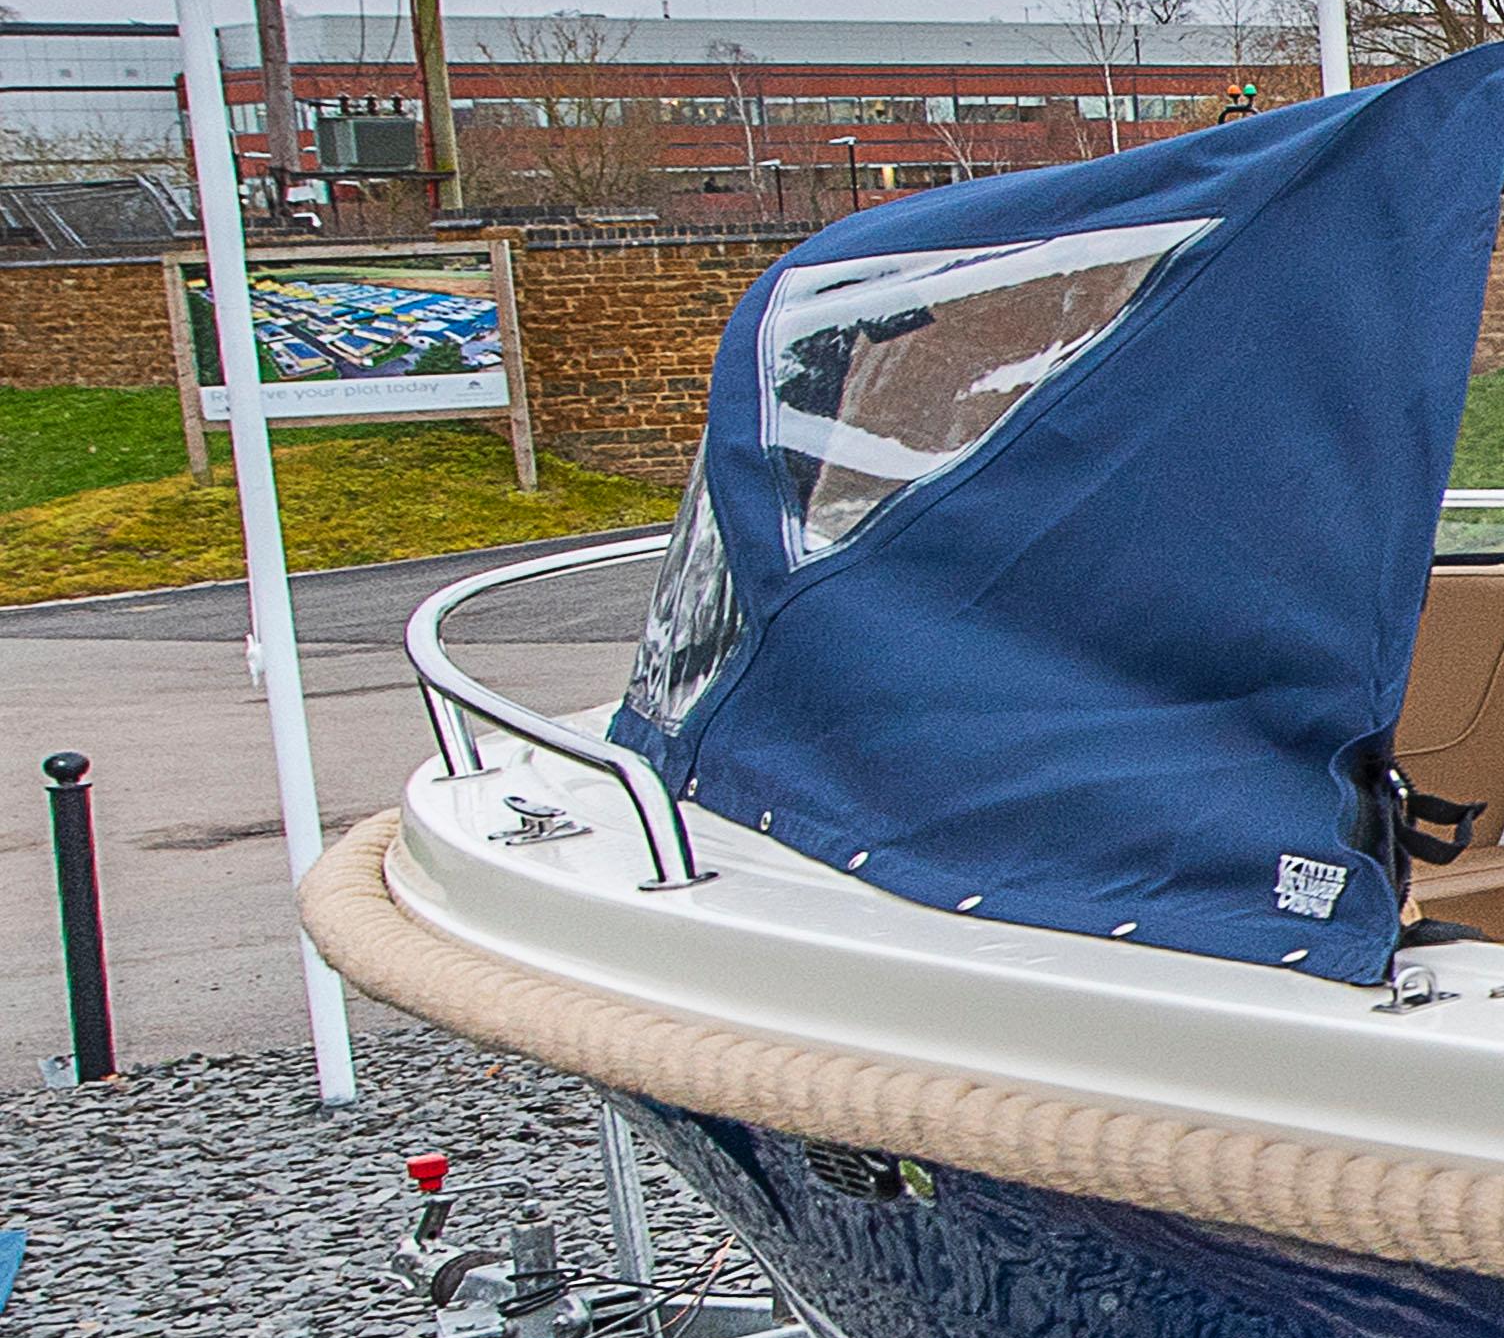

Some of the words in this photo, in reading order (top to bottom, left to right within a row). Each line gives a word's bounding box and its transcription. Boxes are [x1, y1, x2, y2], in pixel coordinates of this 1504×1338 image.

[294, 387, 337, 401] your
[344, 381, 381, 398] plot
[387, 379, 440, 396] today
